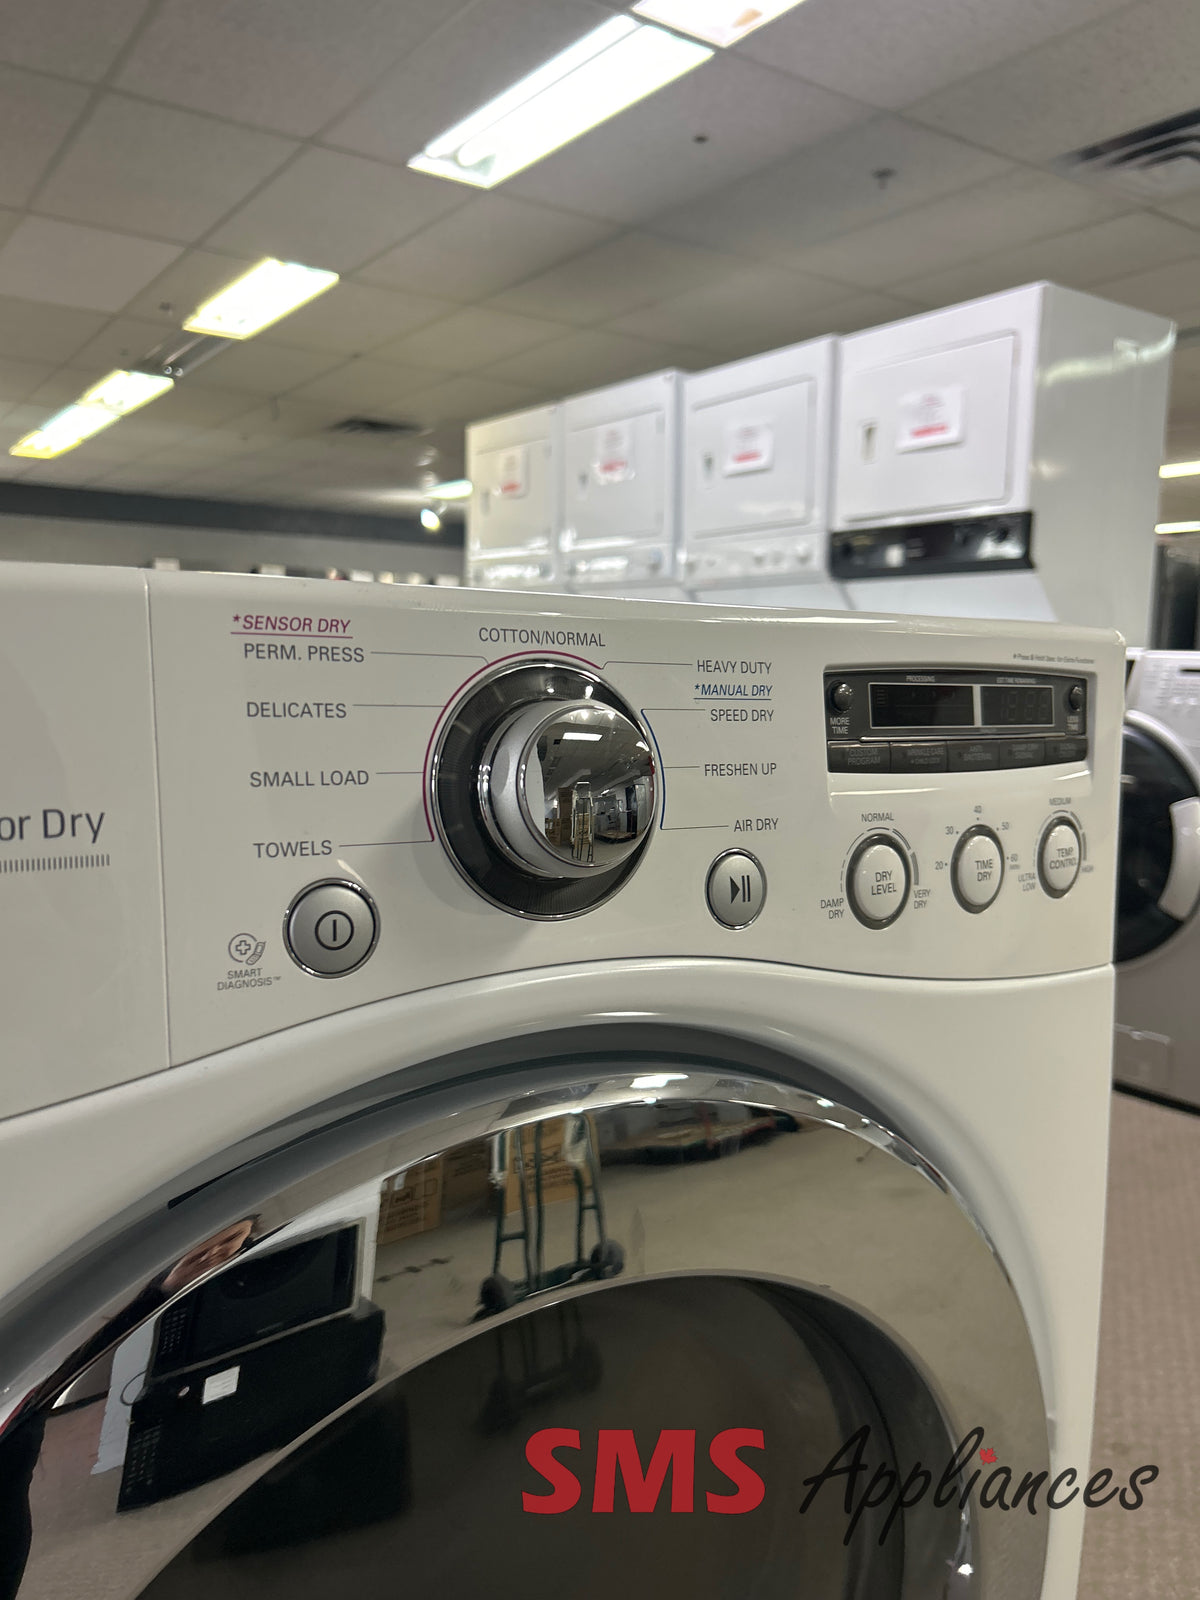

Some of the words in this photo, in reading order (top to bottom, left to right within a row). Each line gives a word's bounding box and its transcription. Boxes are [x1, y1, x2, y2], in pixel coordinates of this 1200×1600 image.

[316, 618, 351, 634] DRY
[478, 627, 607, 647] COTTON/NORMAL
[243, 643, 303, 662] PERM.
[307, 645, 365, 663] PRESS
[696, 659, 737, 674] HEAVY
[739, 661, 773, 675] DUTY
[750, 683, 774, 697] DRY
[246, 702, 348, 719] DELICATES
[709, 708, 750, 722] SPEED
[751, 709, 775, 723] DRY
[829, 717, 851, 726] MORE
[831, 726, 849, 735] TIME
[704, 763, 758, 777] FRESHEN
[761, 763, 778, 776] UP
[249, 771, 315, 788] SMALL
[319, 770, 370, 787] LOAD
[861, 812, 895, 823] NORMAL
[42, 808, 105, 844] Dry
[733, 819, 755, 832] AIR
[756, 818, 779, 832] DRY
[945, 826, 954, 836] 30
[253, 841, 333, 859] TOWELS
[1056, 847, 1075, 858] TEMP
[935, 861, 944, 871] 20
[975, 860, 993, 871] TIME
[1049, 857, 1077, 870] CONTROL
[875, 871, 893, 882] DRY
[977, 871, 992, 882] DRY
[871, 882, 897, 896] LEVEL
[913, 889, 931, 899] VERY
[820, 898, 845, 909] DAMP
[913, 899, 927, 909] DRY
[828, 909, 845, 920] DRY
[226, 968, 263, 980] SMART
